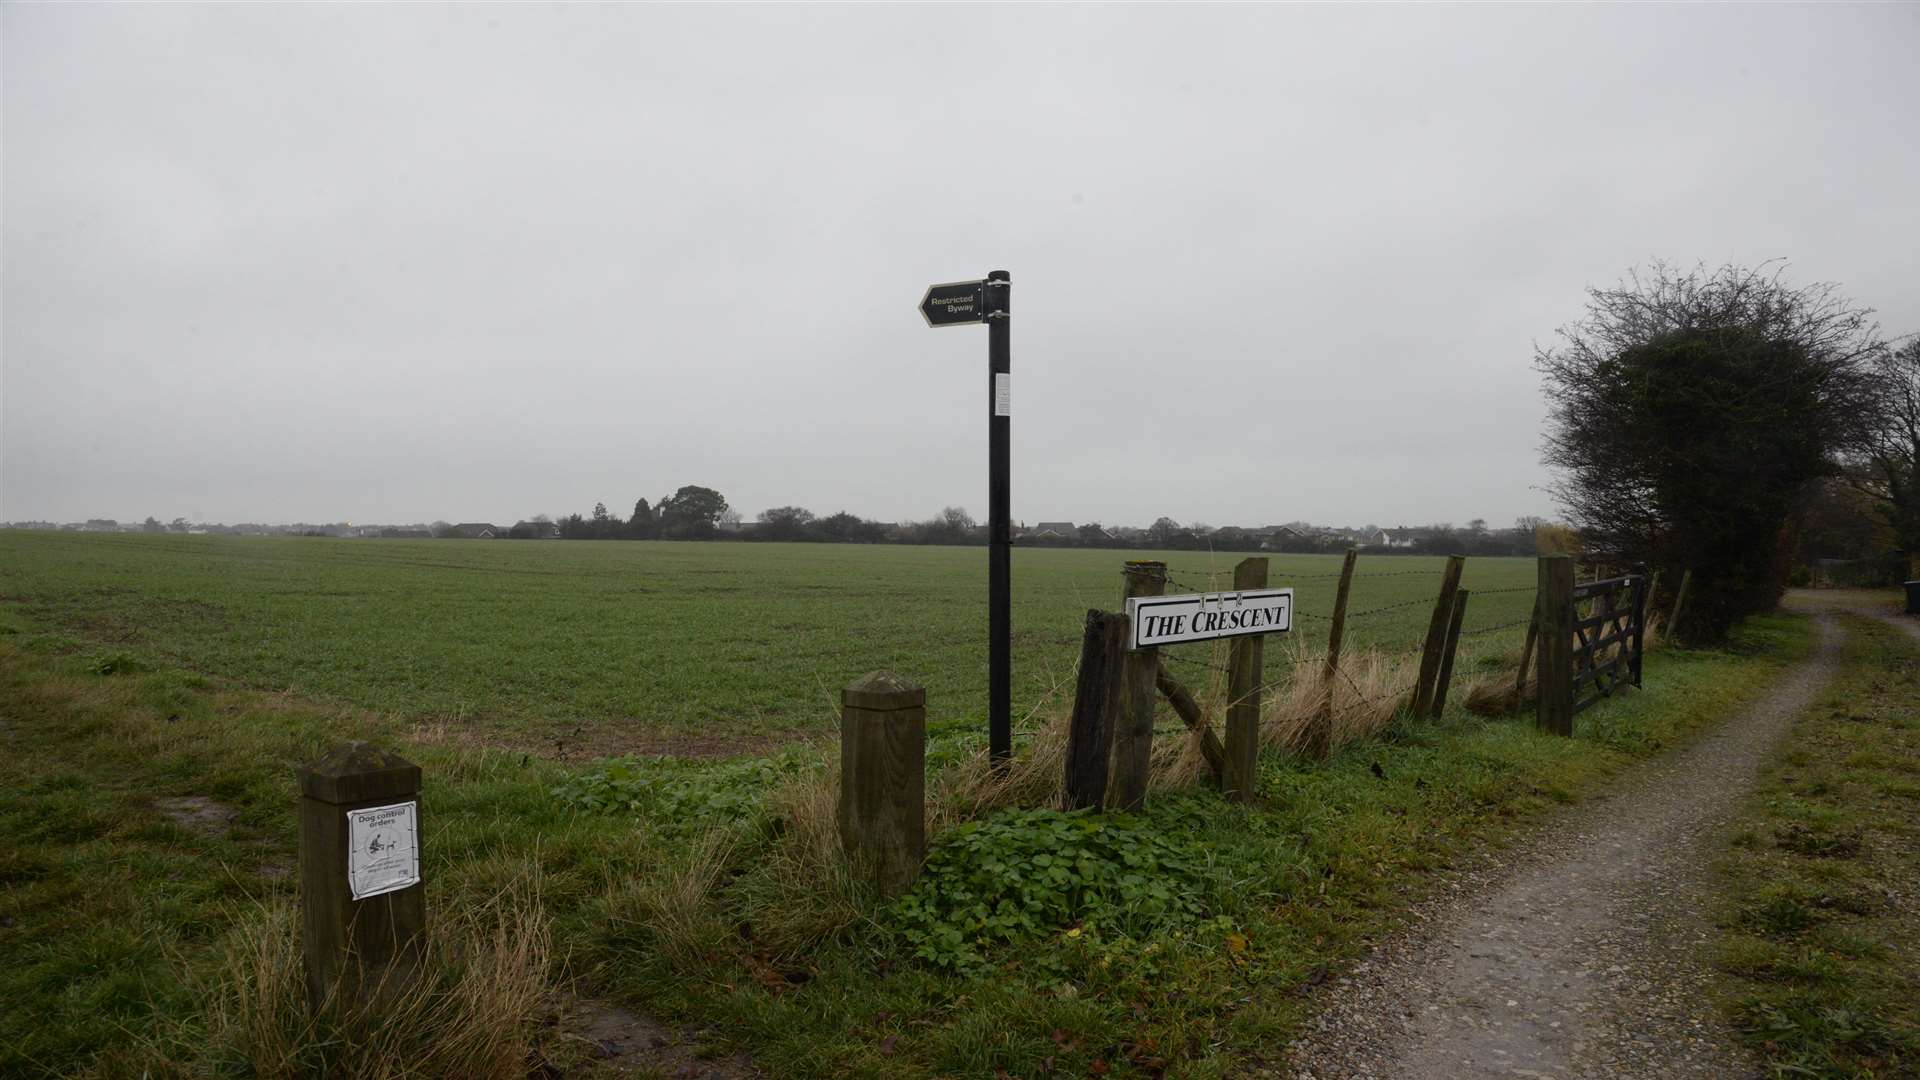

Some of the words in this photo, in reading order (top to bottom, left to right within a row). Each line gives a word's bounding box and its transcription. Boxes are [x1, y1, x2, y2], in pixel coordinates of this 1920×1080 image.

[931, 294, 974, 305] Restricted
[947, 304, 974, 313] Byway
[1144, 614, 1187, 638] THE
[1191, 606, 1285, 633] CRESCENT
[358, 815, 376, 823] Dog
[377, 808, 406, 820] control
[369, 819, 396, 828] orders
